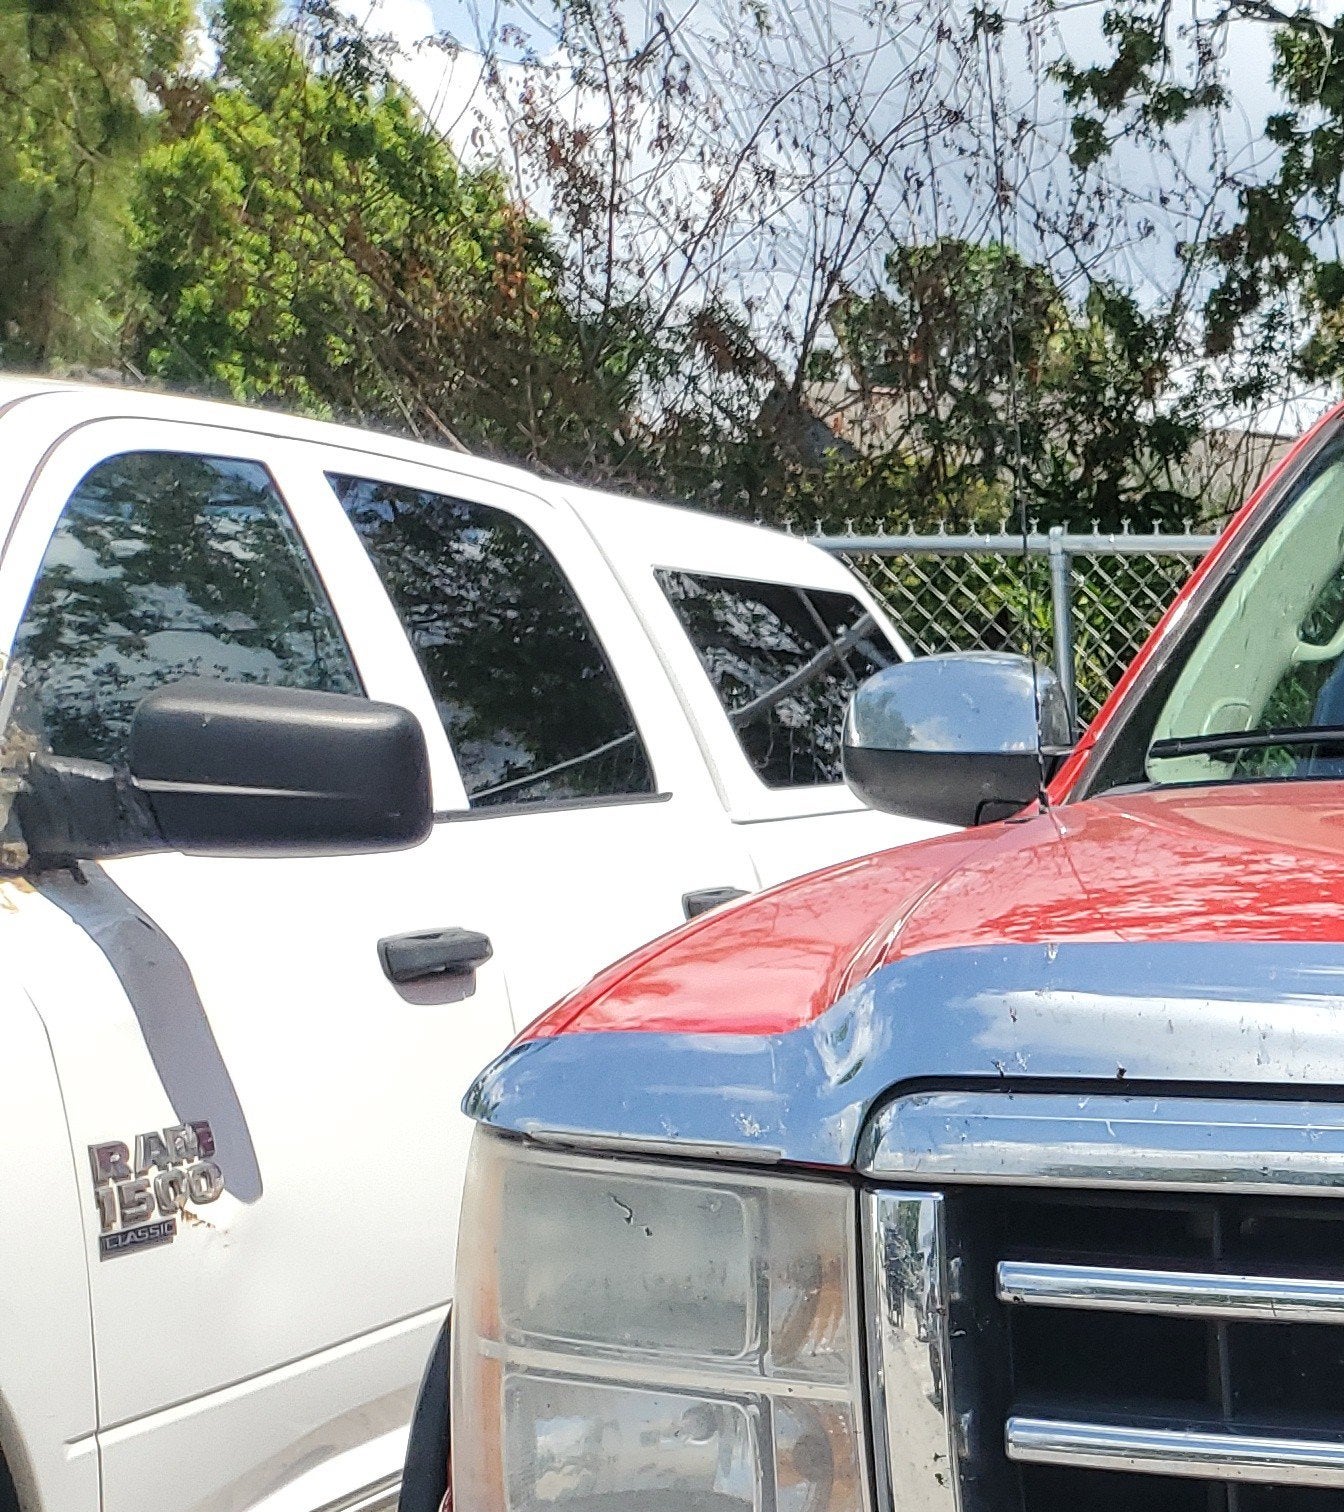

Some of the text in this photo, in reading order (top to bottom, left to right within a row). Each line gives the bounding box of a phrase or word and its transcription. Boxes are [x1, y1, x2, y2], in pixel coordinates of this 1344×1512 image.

[88, 1120, 215, 1187] RAM
[95, 1161, 224, 1234] 1500
[105, 1221, 174, 1251] CLASSIC
